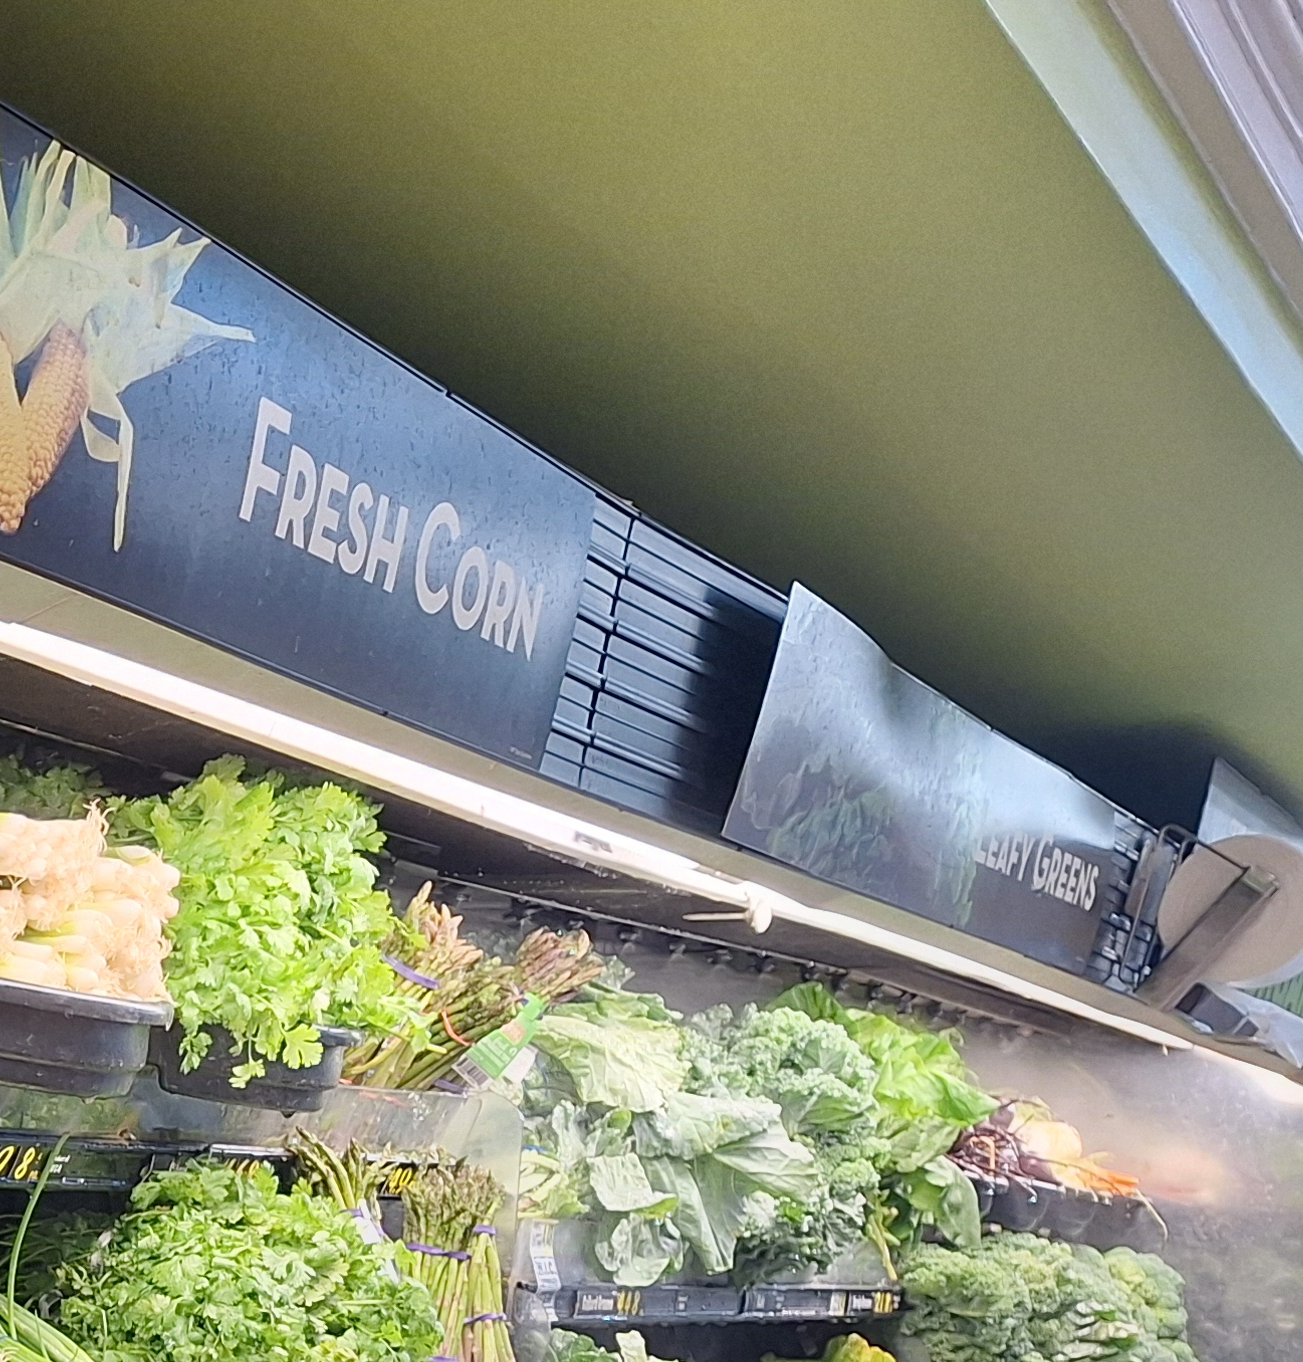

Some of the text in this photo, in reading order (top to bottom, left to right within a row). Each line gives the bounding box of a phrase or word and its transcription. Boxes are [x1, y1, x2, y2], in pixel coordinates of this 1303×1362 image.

[238, 396, 545, 662] FRESH CORN
[974, 833, 1099, 912] LEAFY GREENS
